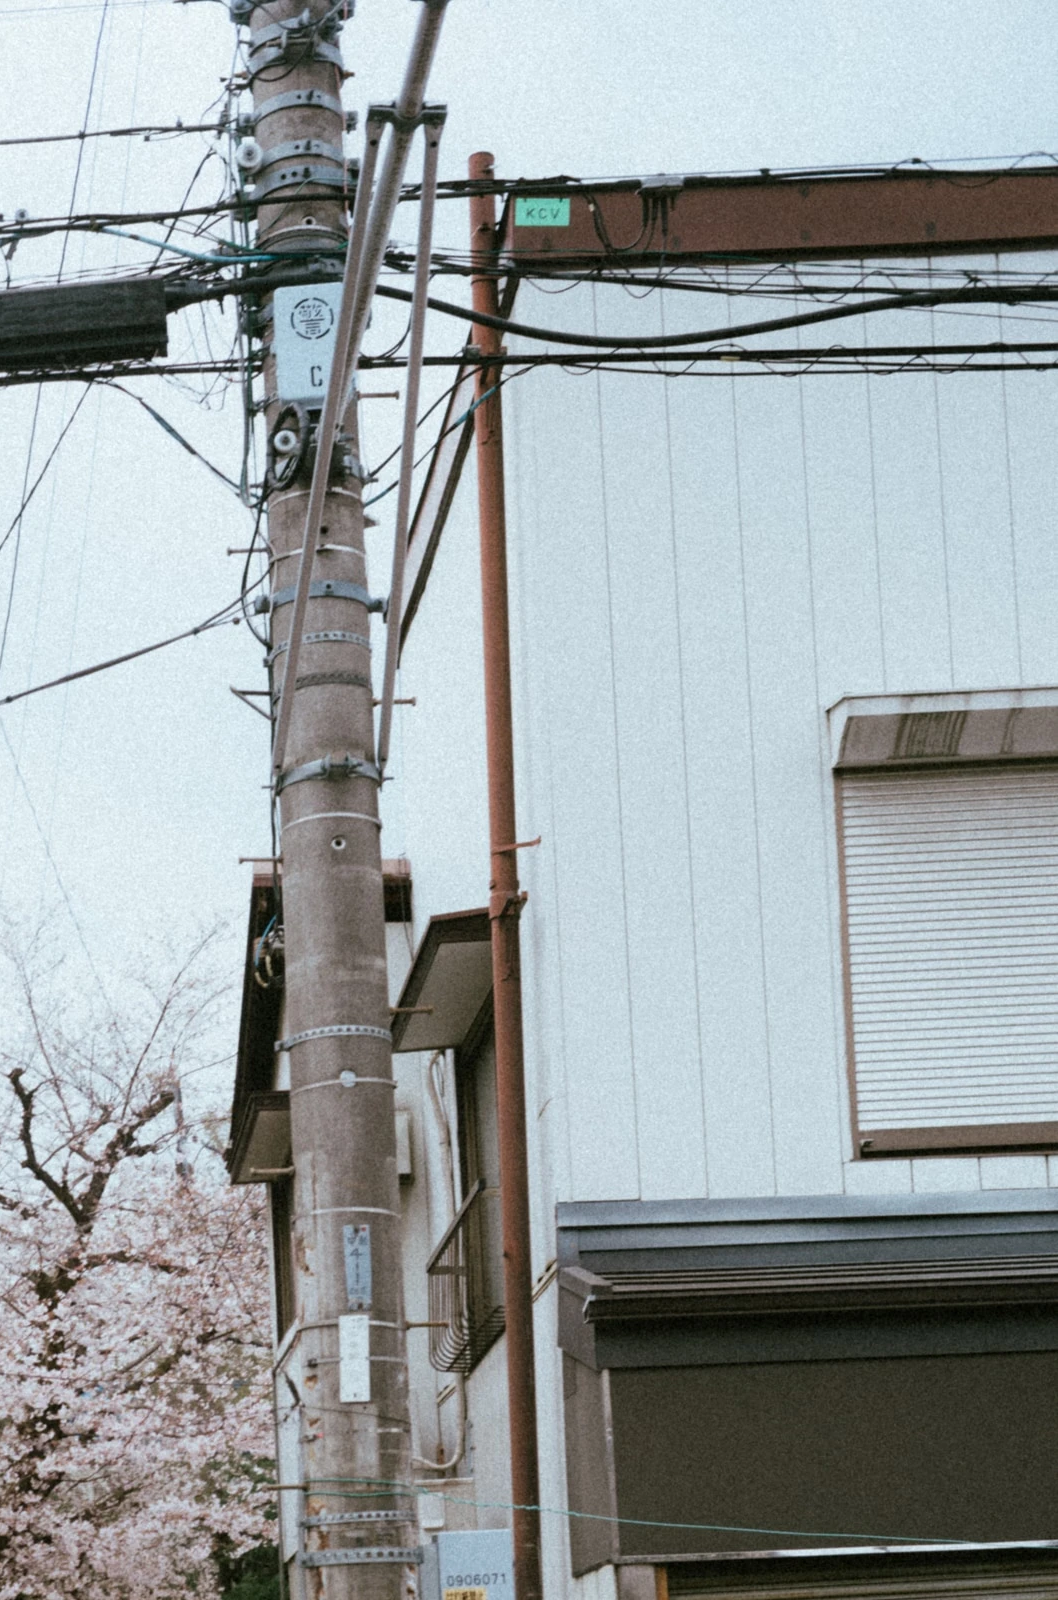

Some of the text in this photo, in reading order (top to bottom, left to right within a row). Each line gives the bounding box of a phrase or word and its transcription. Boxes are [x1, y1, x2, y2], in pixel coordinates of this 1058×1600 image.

[525, 207, 561, 219] KCV
[310, 365, 323, 387] C
[446, 1572, 507, 1587] 0906071
